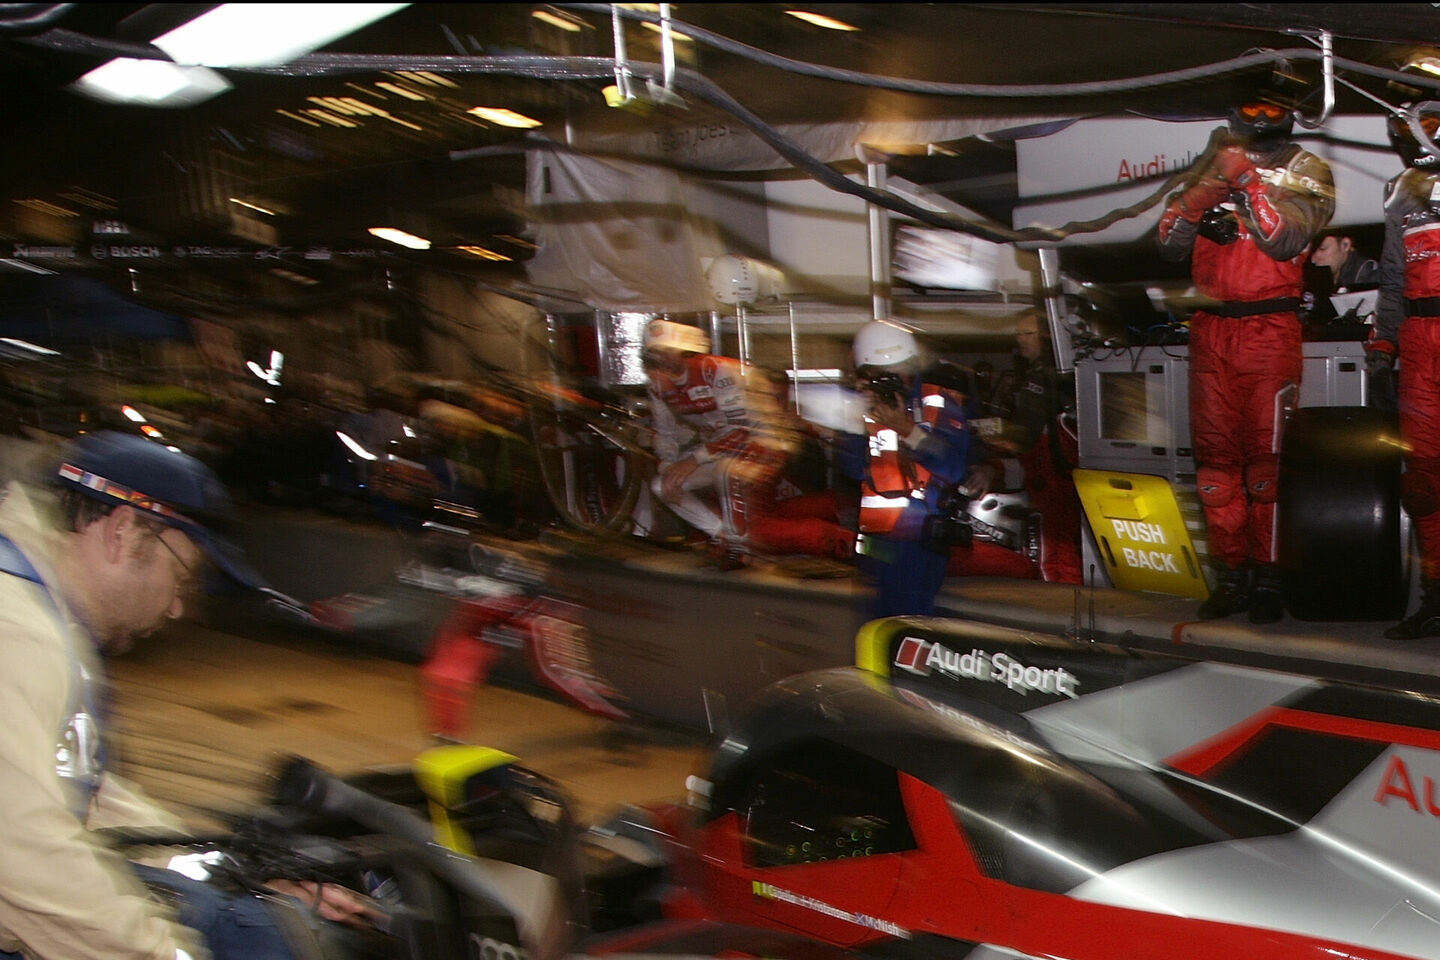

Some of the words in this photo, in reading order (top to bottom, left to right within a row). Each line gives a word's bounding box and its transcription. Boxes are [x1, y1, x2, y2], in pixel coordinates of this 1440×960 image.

[1117, 154, 1166, 182] Audi
[1111, 519, 1166, 545] PUSH
[1122, 547, 1179, 573] BACK
[926, 642, 983, 676] Audi
[990, 652, 1068, 693] Sport
